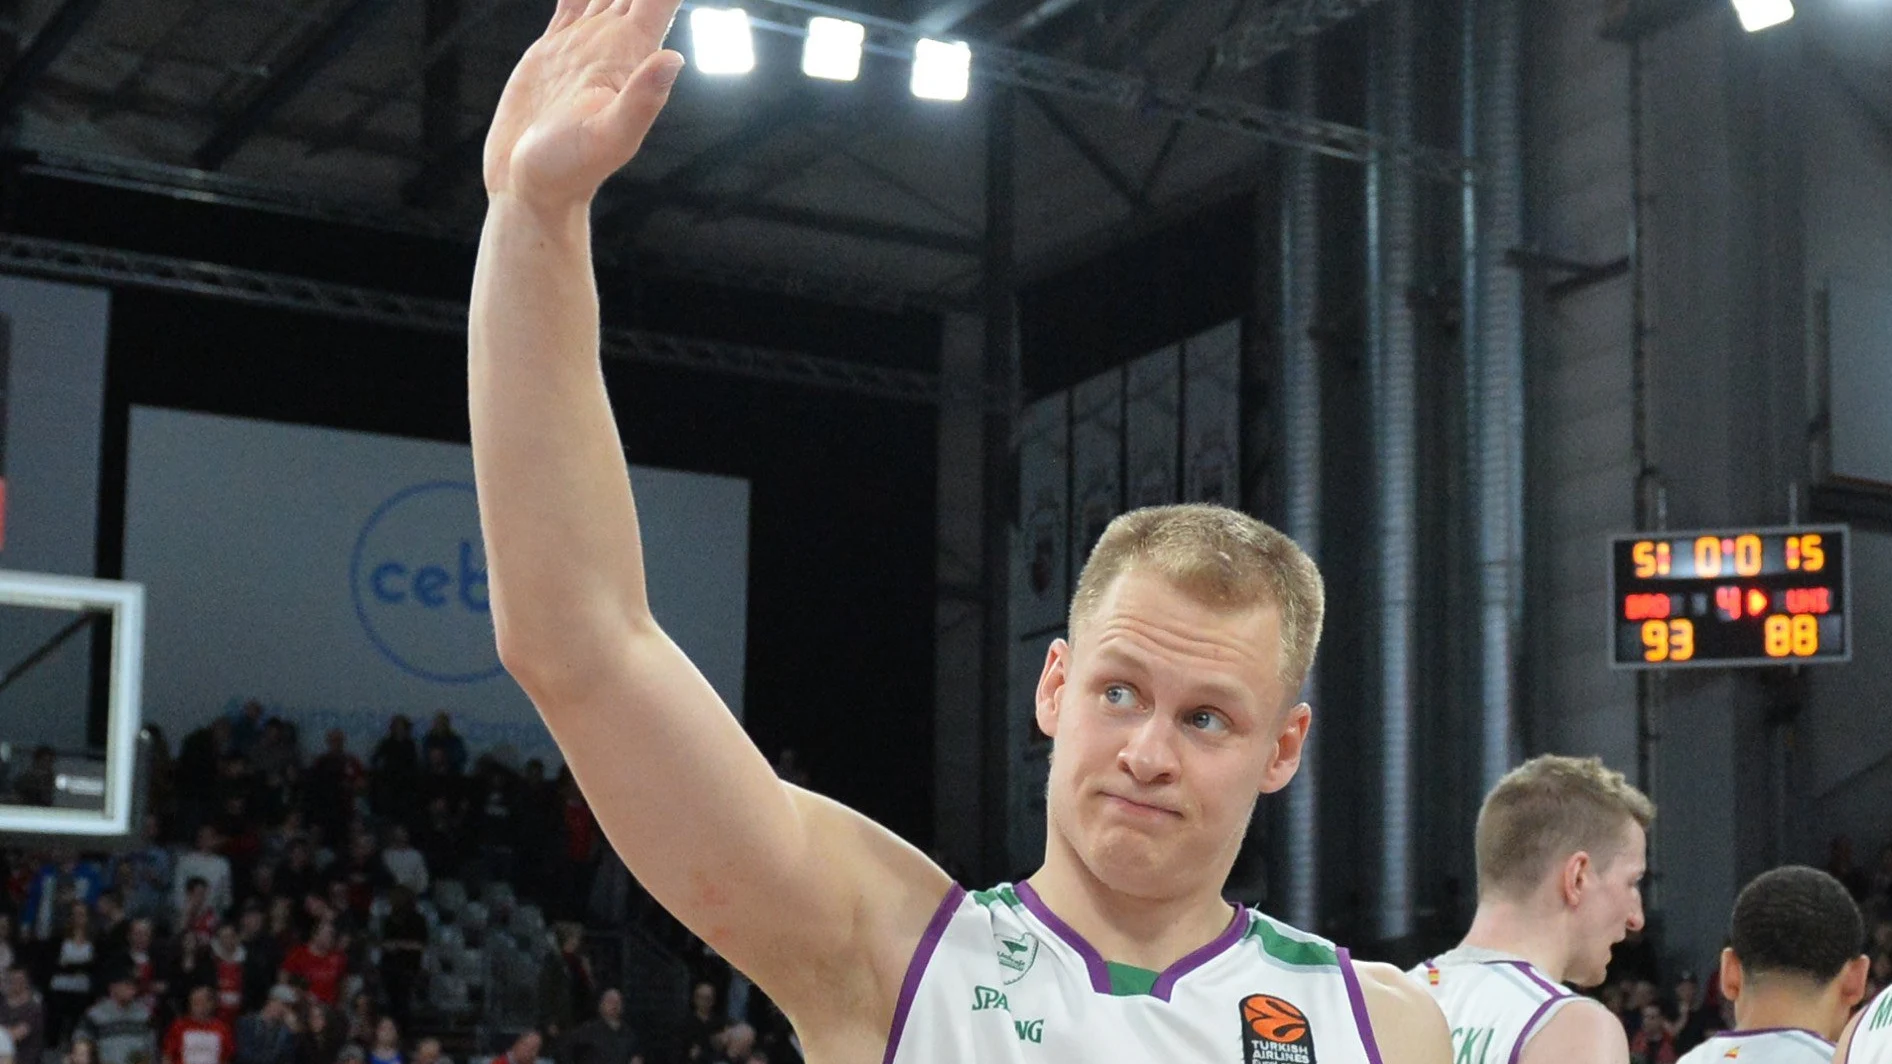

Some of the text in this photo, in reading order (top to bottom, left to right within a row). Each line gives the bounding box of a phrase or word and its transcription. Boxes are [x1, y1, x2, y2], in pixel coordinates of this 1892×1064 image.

[1641, 613, 1819, 662] 93 88
[1251, 1040, 1308, 1055] TURKISH
[1252, 1050, 1310, 1064] AIRLINES
